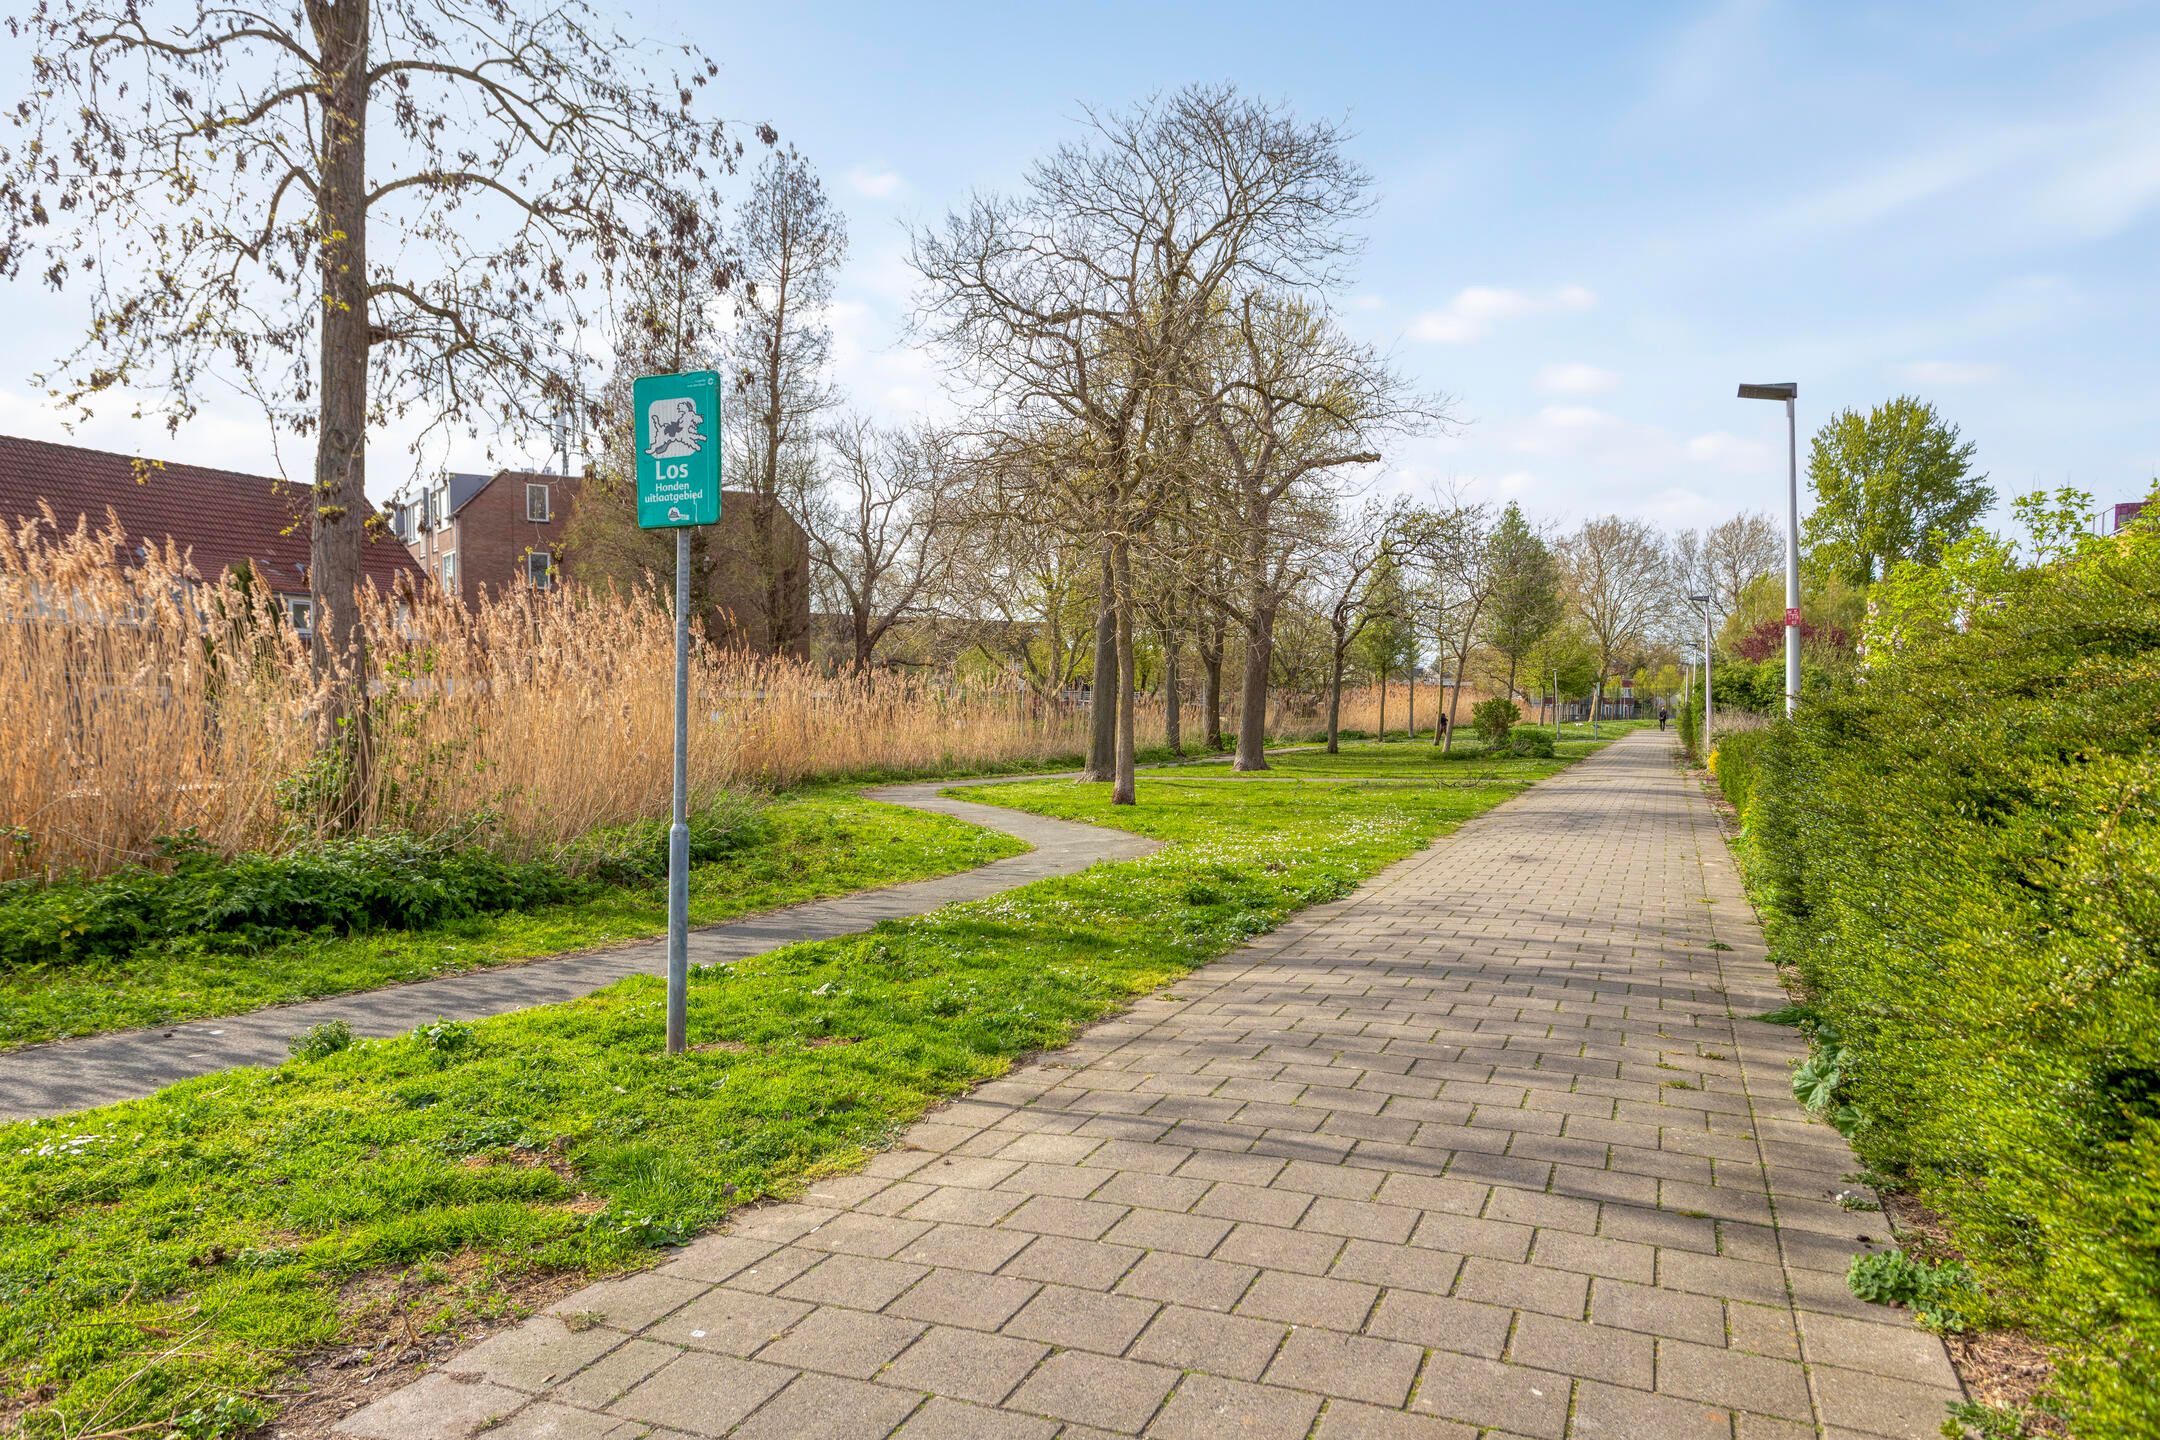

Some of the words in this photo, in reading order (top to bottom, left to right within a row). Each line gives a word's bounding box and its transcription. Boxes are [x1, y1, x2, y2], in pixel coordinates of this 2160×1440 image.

[655, 460, 689, 480] Los
[655, 481, 690, 492] Honden
[644, 489, 703, 504] uitlaatgebied
